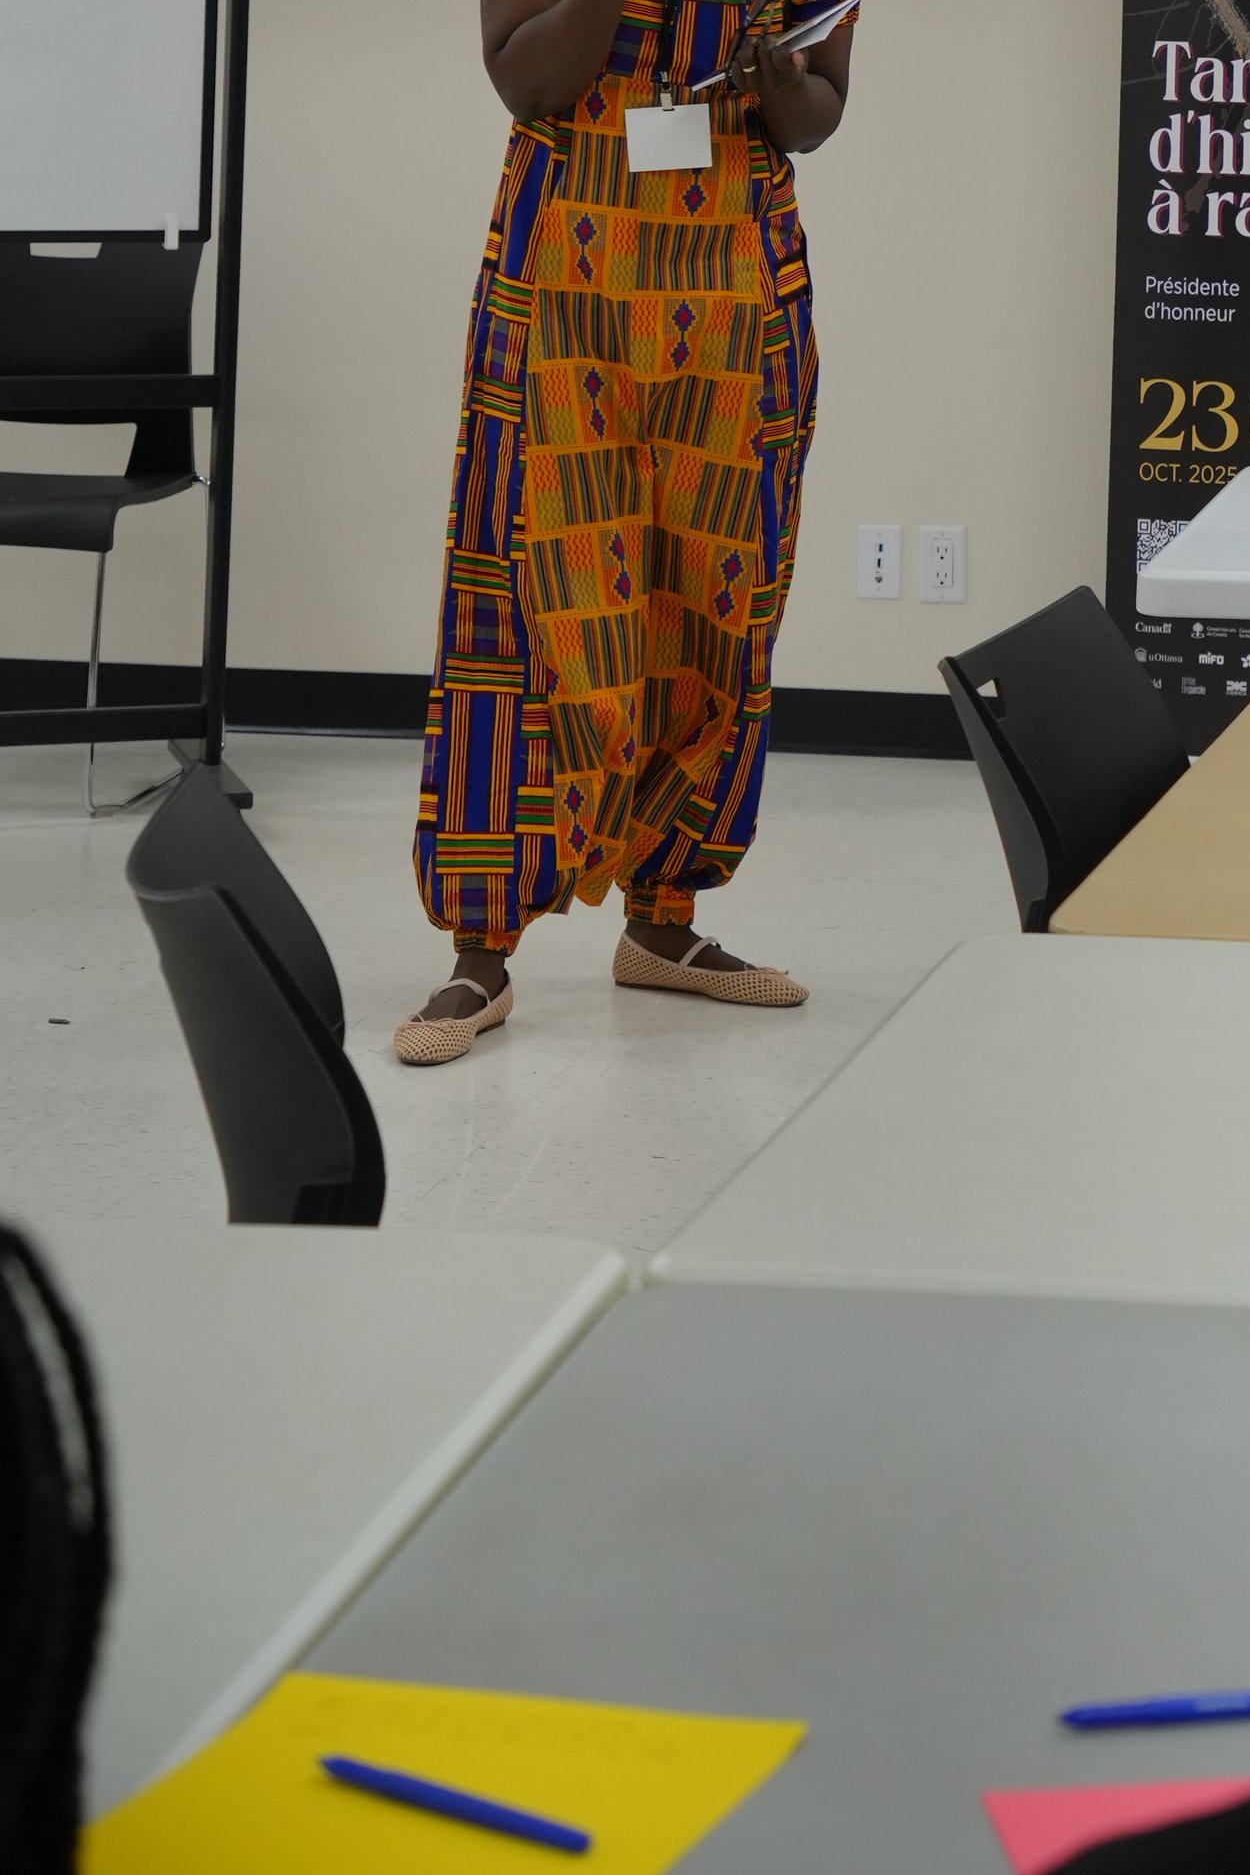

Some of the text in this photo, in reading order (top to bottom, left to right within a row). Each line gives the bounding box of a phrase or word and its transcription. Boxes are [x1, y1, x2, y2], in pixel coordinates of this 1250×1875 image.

[1147, 178, 1183, 236] à
[1145, 275, 1240, 297] Présidente
[1144, 301, 1236, 323] d'honneur
[1139, 377, 1239, 453] 23
[1139, 462, 1182, 483] OCT.
[1135, 621, 1172, 634] Canada
[1148, 652, 1183, 663] uOttawa
